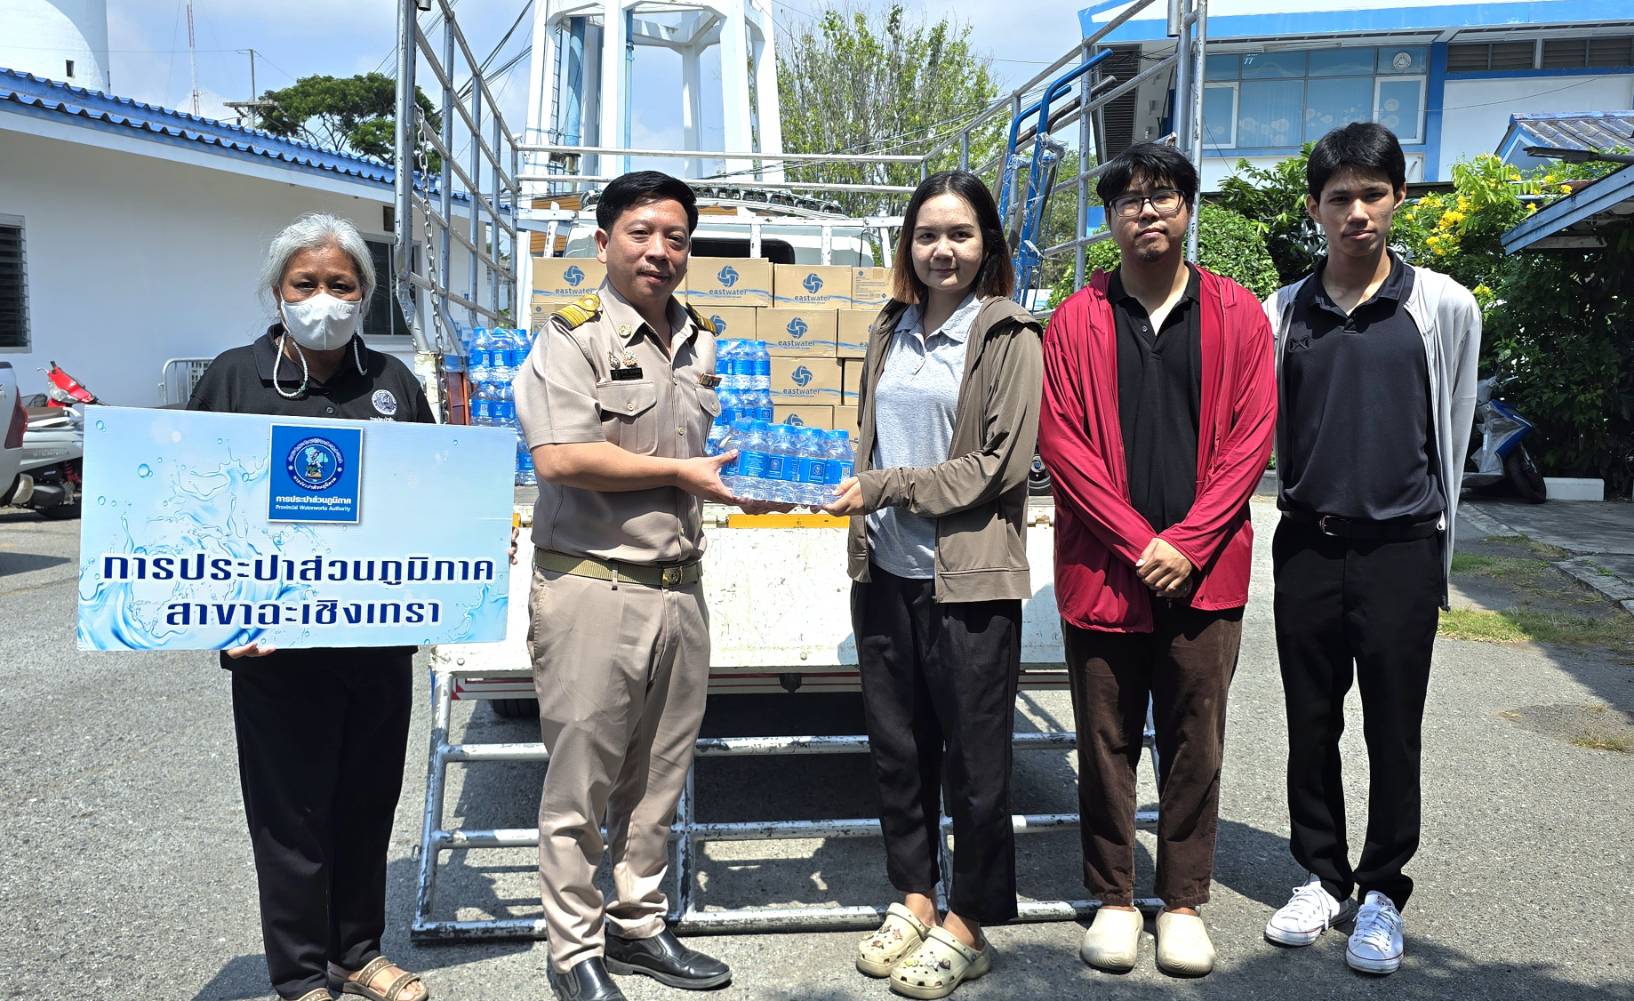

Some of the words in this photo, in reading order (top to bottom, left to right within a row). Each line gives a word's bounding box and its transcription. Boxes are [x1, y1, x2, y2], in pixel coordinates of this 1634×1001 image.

[275, 495, 352, 506] การประปาส่วนภูมิภาค
[103, 553, 493, 586] การประปาส่วนภูมิภาค
[166, 600, 440, 625] สาขาฉะเชิงเทรา
